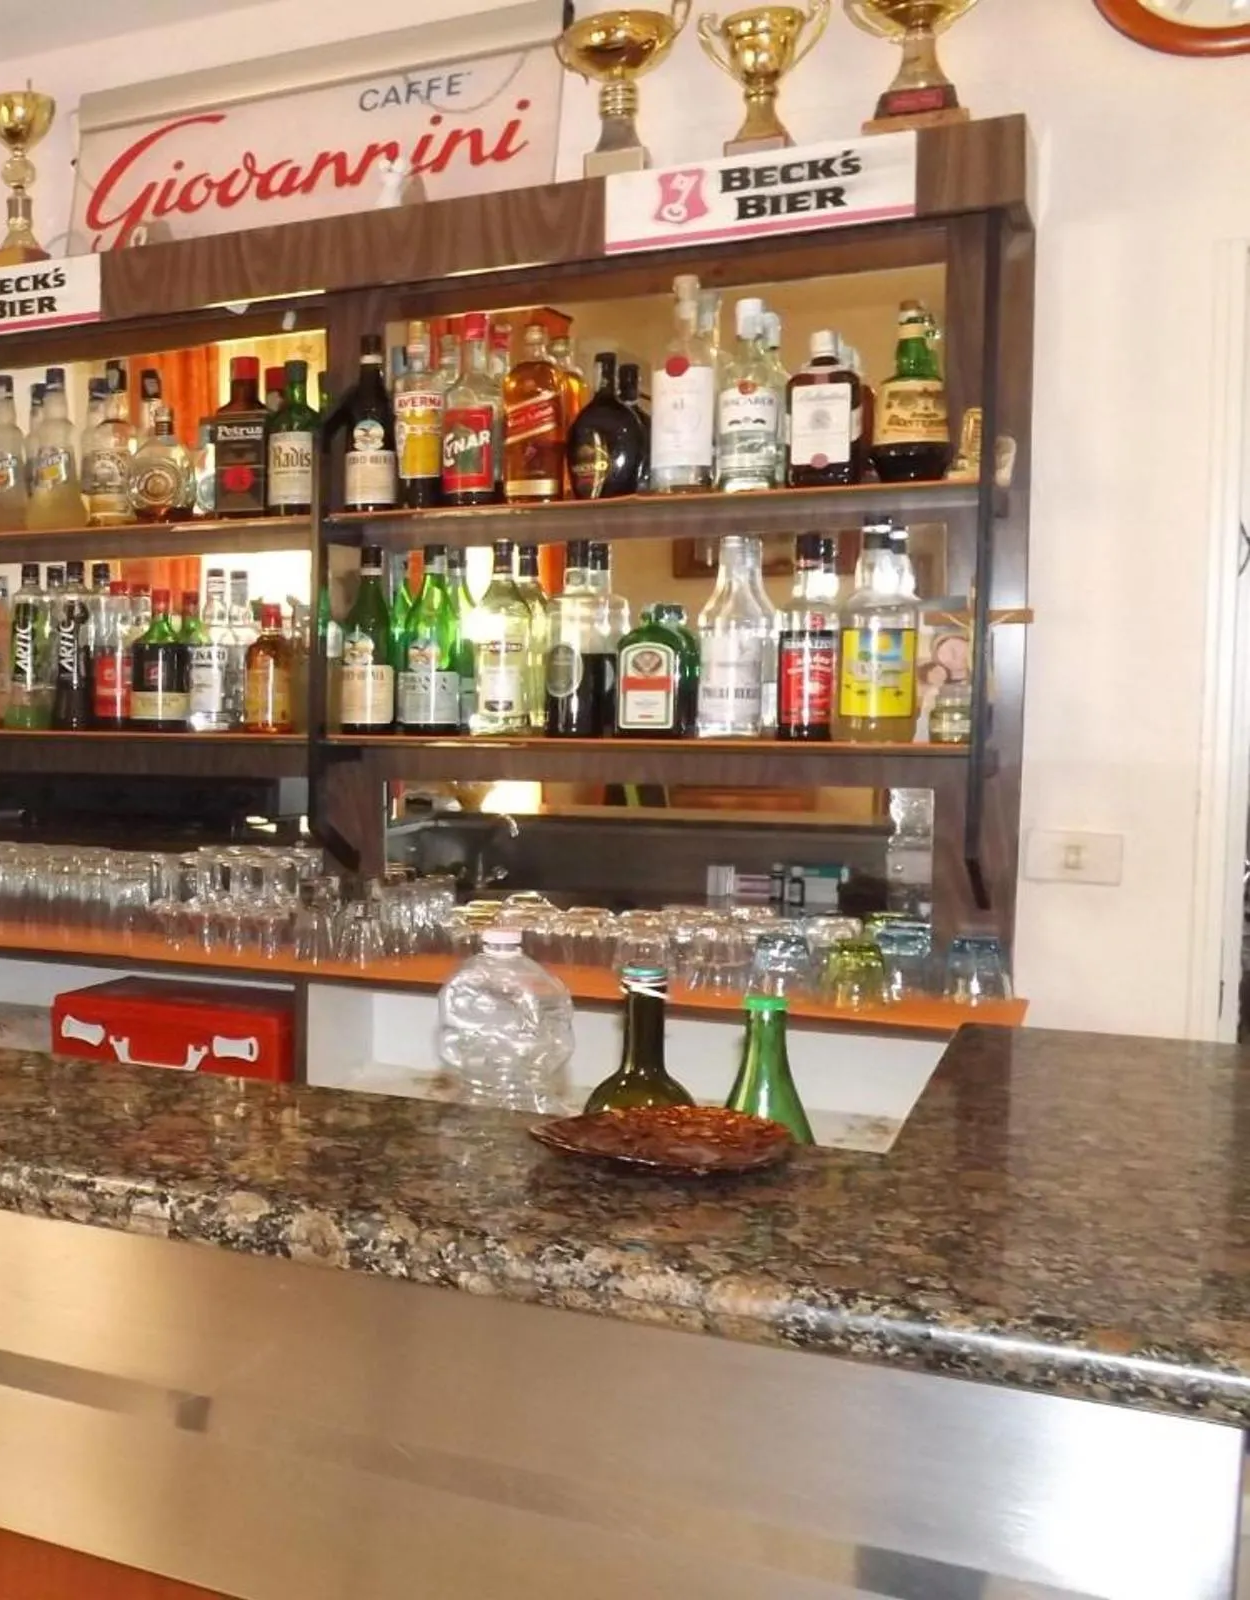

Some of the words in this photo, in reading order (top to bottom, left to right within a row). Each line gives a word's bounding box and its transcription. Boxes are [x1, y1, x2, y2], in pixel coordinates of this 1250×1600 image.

[85, 98, 531, 254] Giovannini
[735, 186, 847, 220] BIER
[217, 425, 263, 437] Petrus
[443, 428, 491, 468] CYNAR
